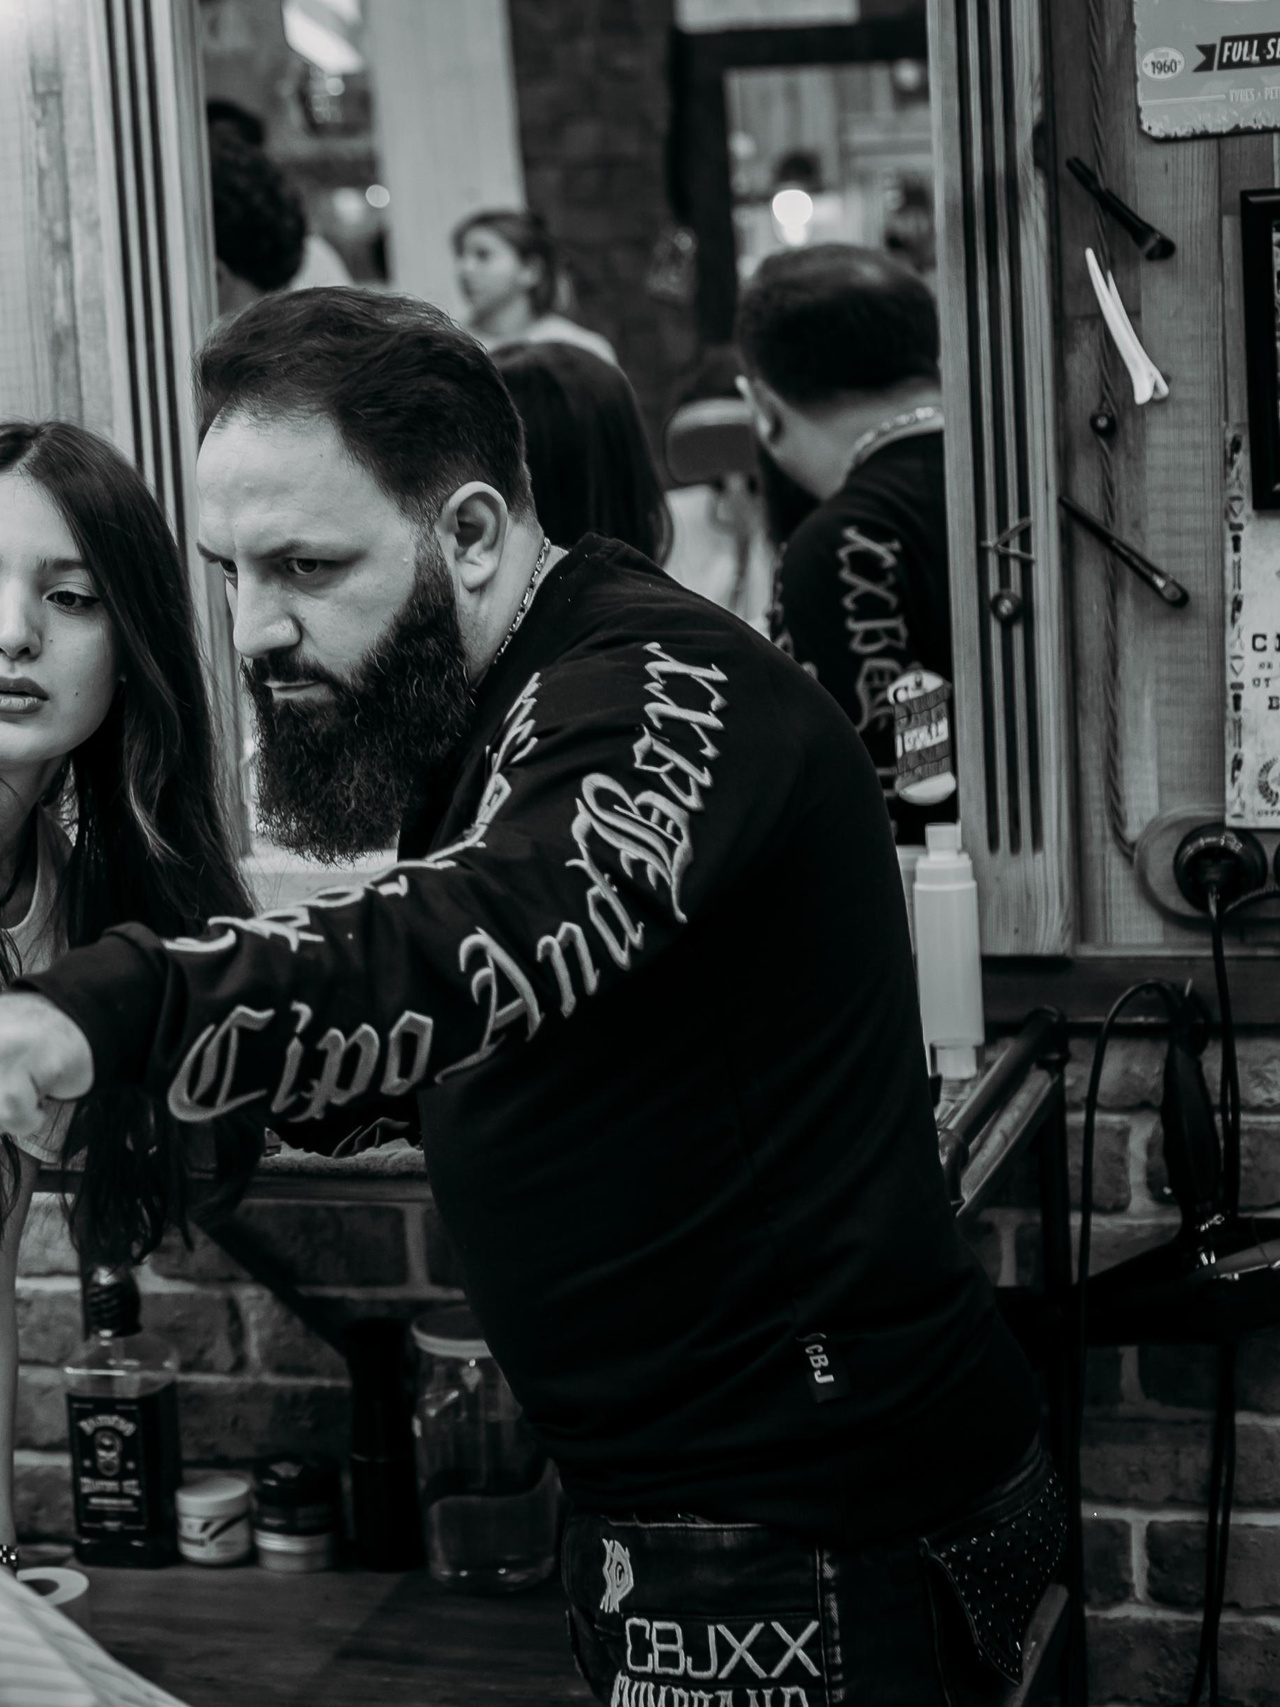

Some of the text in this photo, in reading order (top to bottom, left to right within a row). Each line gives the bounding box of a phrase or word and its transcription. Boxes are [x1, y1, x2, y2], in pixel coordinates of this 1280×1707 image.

[1151, 59, 1178, 75] 1960
[1222, 40, 1260, 63] FULL
[167, 1001, 434, 1122] Cipo
[435, 858, 646, 1085] And
[804, 1344, 835, 1384] CBJ
[625, 1617, 821, 1680] CBJXX
